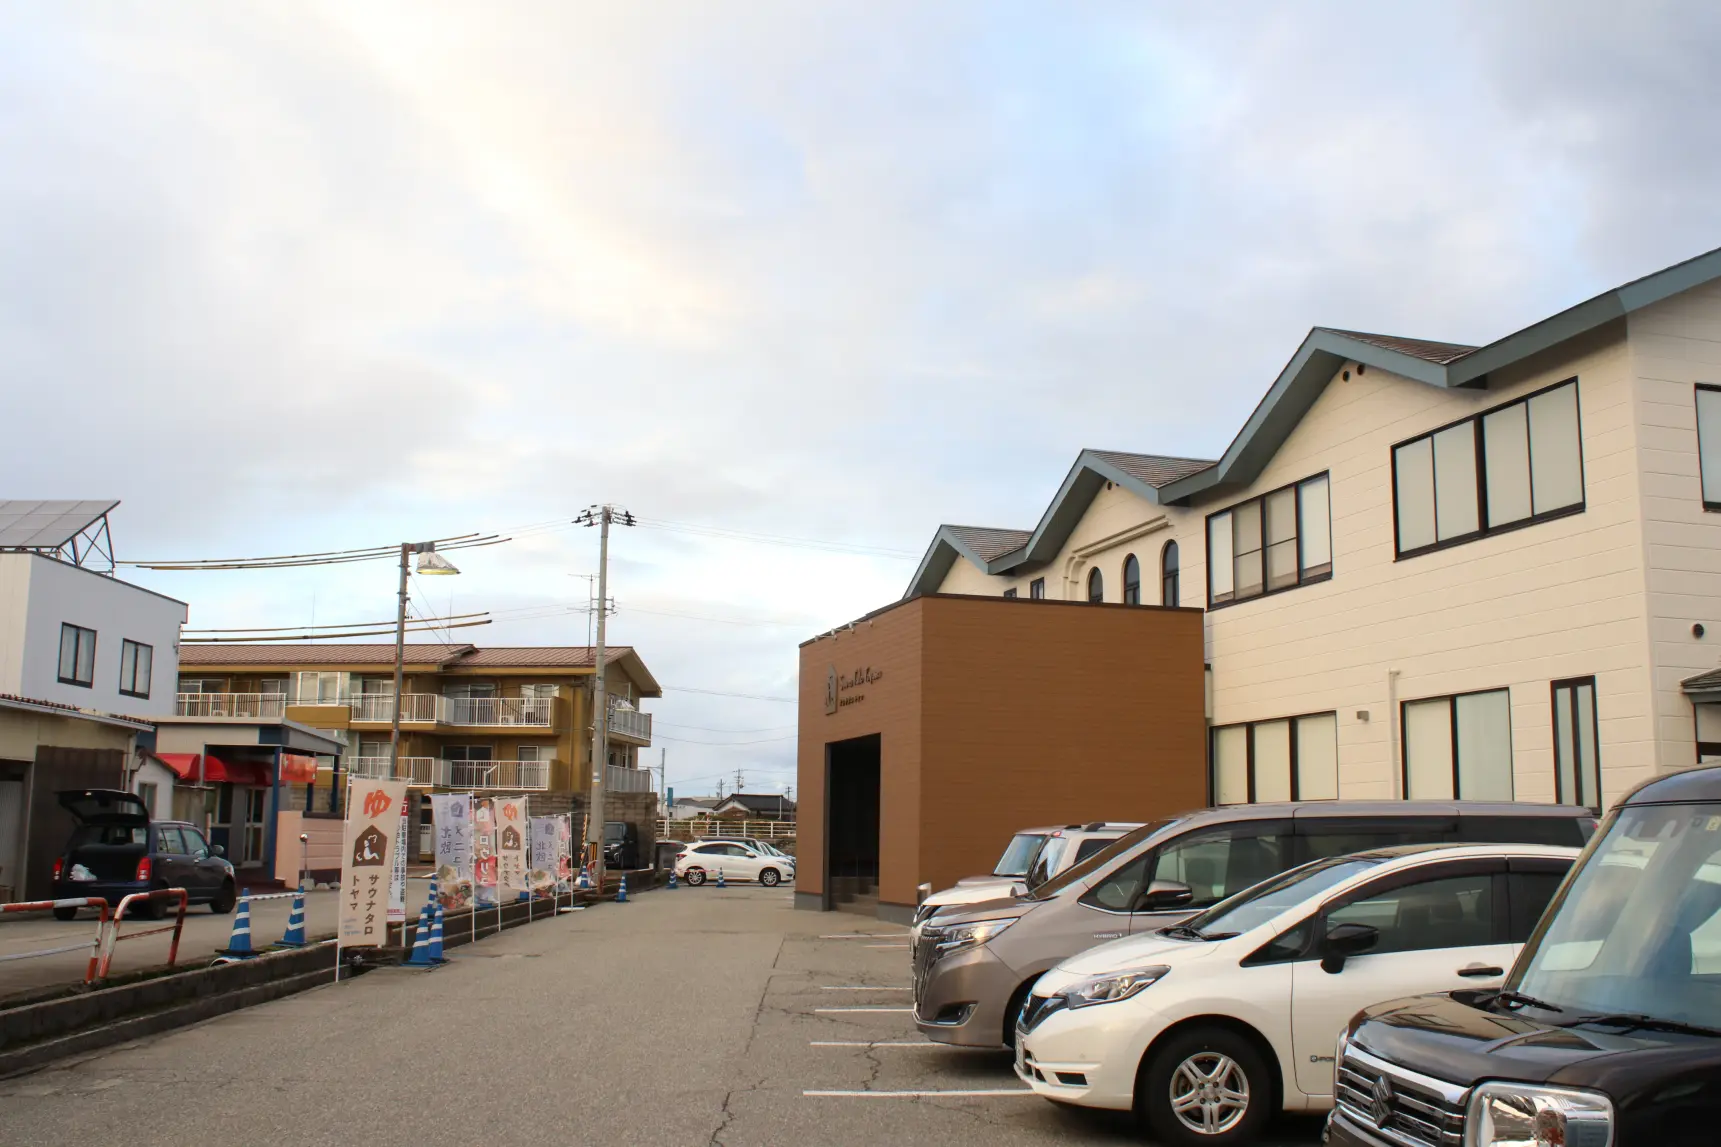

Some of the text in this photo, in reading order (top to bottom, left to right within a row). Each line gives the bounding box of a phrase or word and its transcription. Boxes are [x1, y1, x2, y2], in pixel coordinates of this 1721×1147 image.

[363, 789, 392, 819] ゆ
[350, 875, 360, 911] トヤマ
[364, 874, 380, 936] サウナタロ
